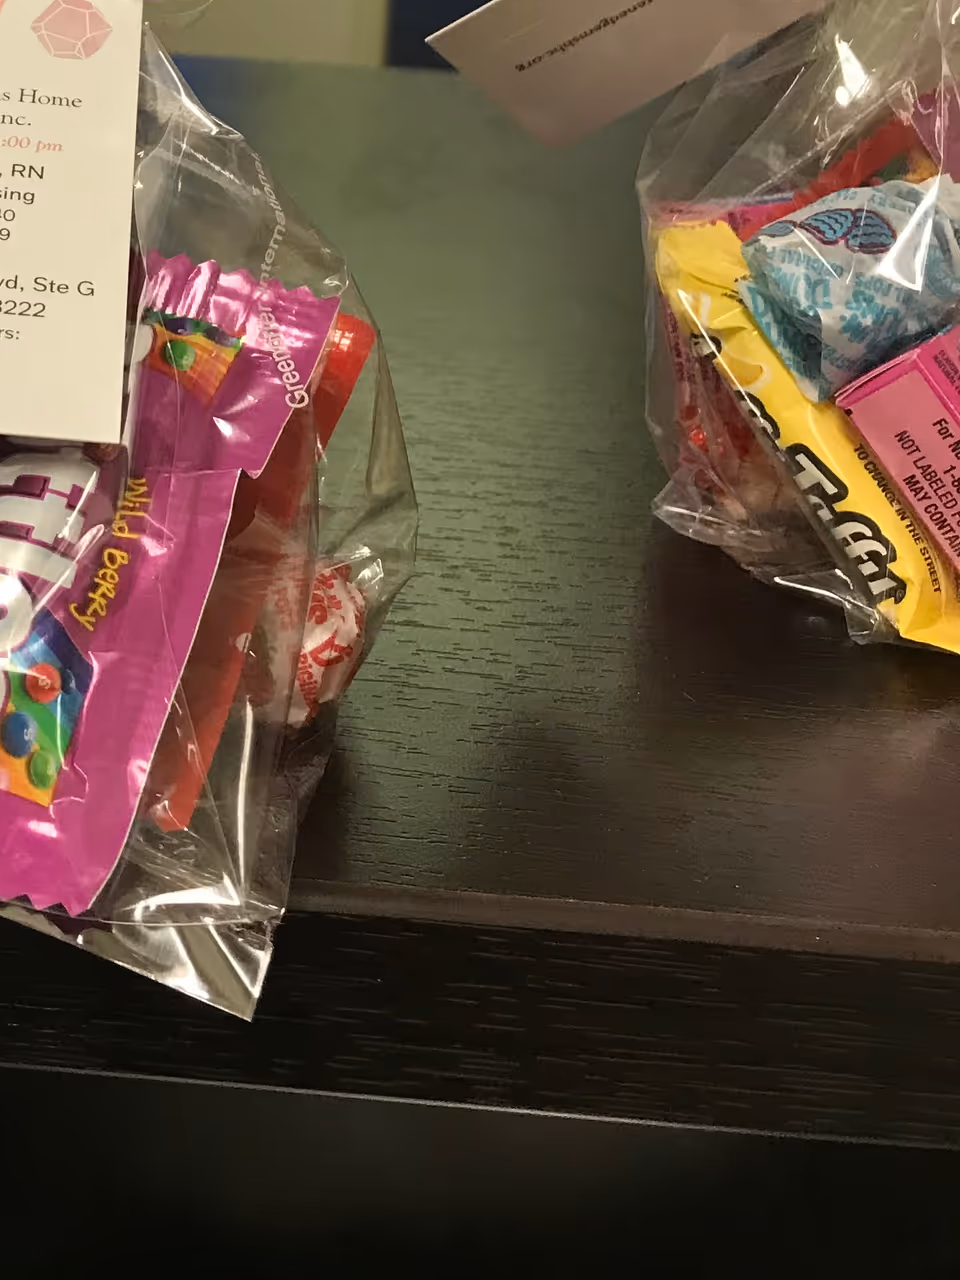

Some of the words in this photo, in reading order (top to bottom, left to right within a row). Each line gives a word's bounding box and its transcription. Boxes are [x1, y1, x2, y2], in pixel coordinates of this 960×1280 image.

[18, 87, 83, 109] Home
[35, 139, 64, 154] pm
[11, 164, 45, 180] RN
[33, 277, 71, 295] Ste
[76, 280, 96, 297] G
[932, 417, 955, 441] For
[894, 429, 922, 457] NOT
[913, 455, 959, 510] LABELED
[902, 473, 932, 503] MAY
[853, 442, 869, 461] TO
[863, 459, 899, 508] CHANGE
[893, 501, 909, 521] IN
[904, 520, 925, 545] THE
[918, 544, 942, 594] STREET
